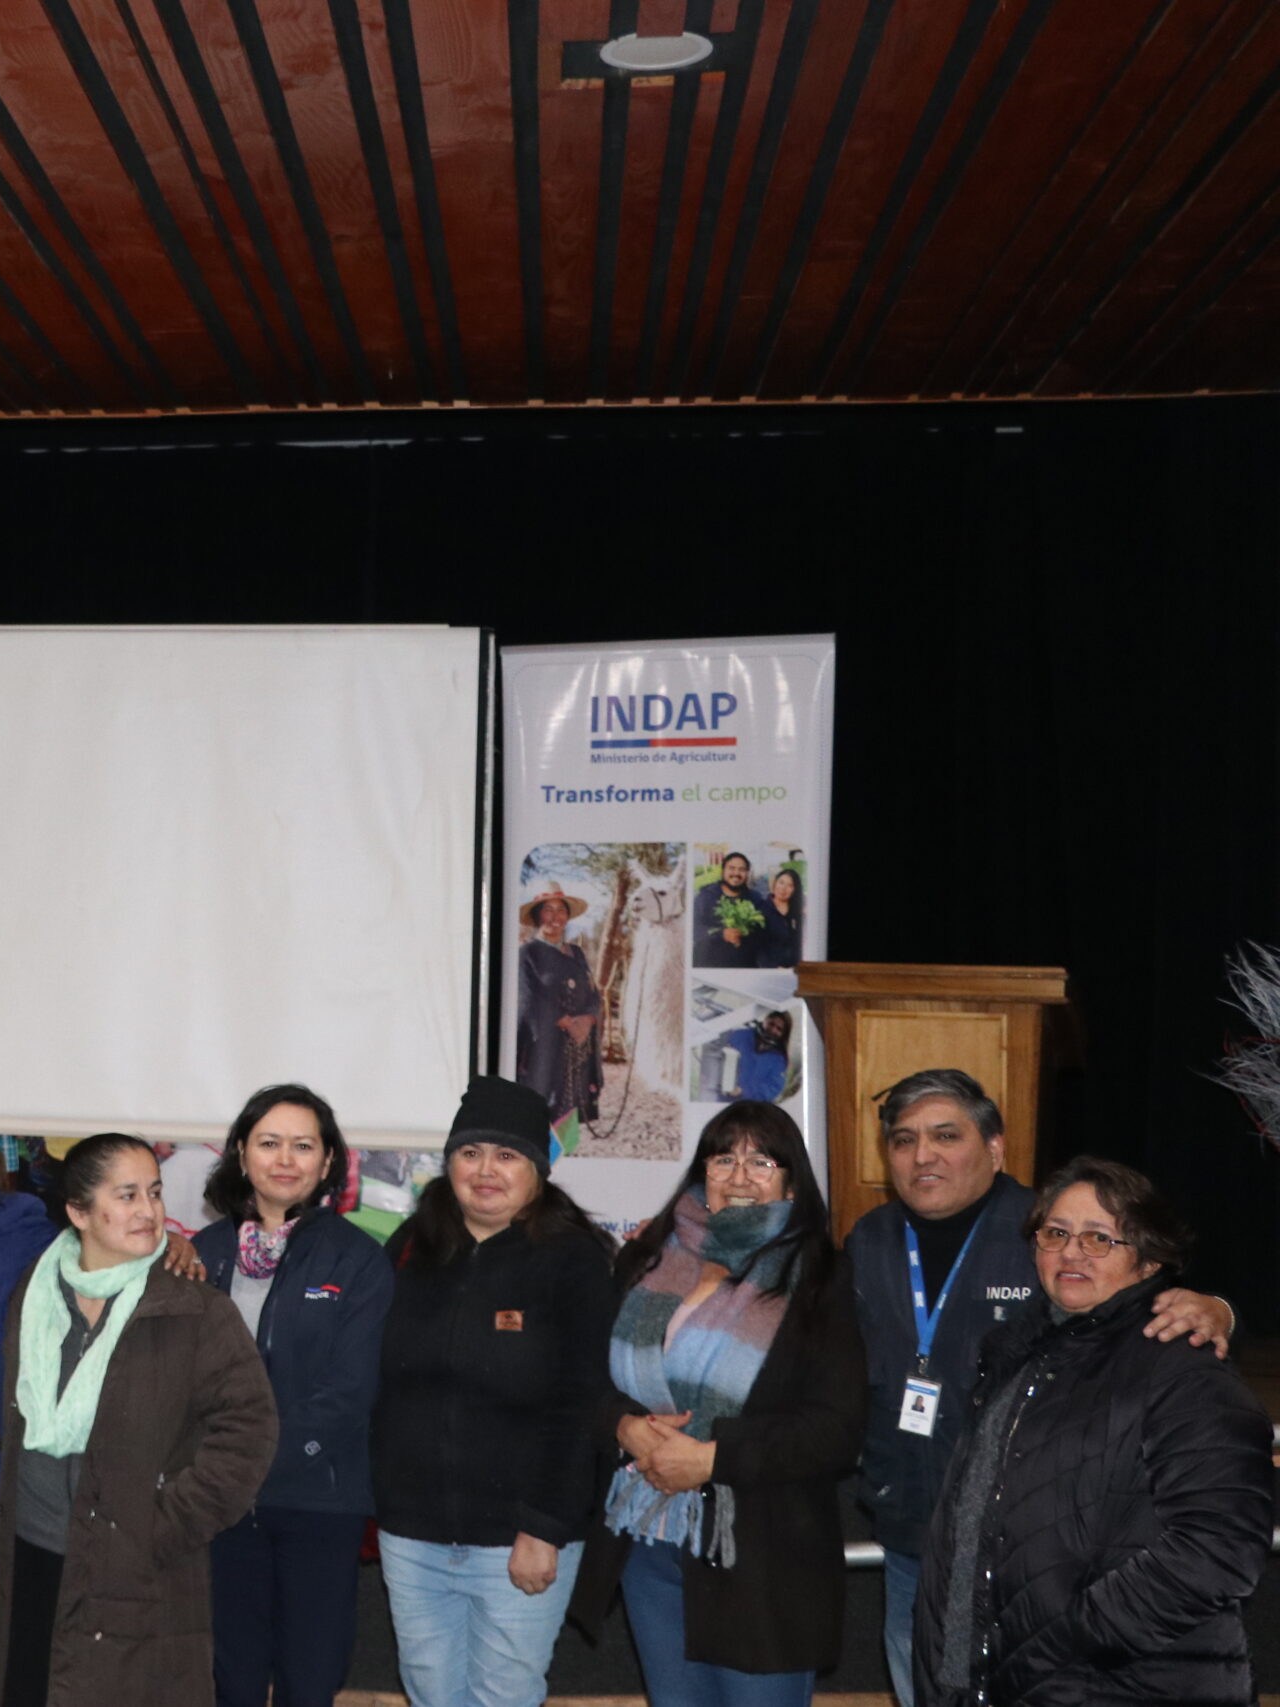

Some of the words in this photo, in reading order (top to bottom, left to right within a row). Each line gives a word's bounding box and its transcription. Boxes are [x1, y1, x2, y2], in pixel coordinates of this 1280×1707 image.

[590, 691, 738, 733] INDAP
[590, 752, 650, 764] Ministerio
[652, 751, 667, 763] de
[669, 750, 737, 764] Agricultura
[541, 784, 675, 804] Transforma
[682, 783, 701, 803] el
[708, 785, 787, 805] campo
[986, 1287, 1031, 1300] INDAP
